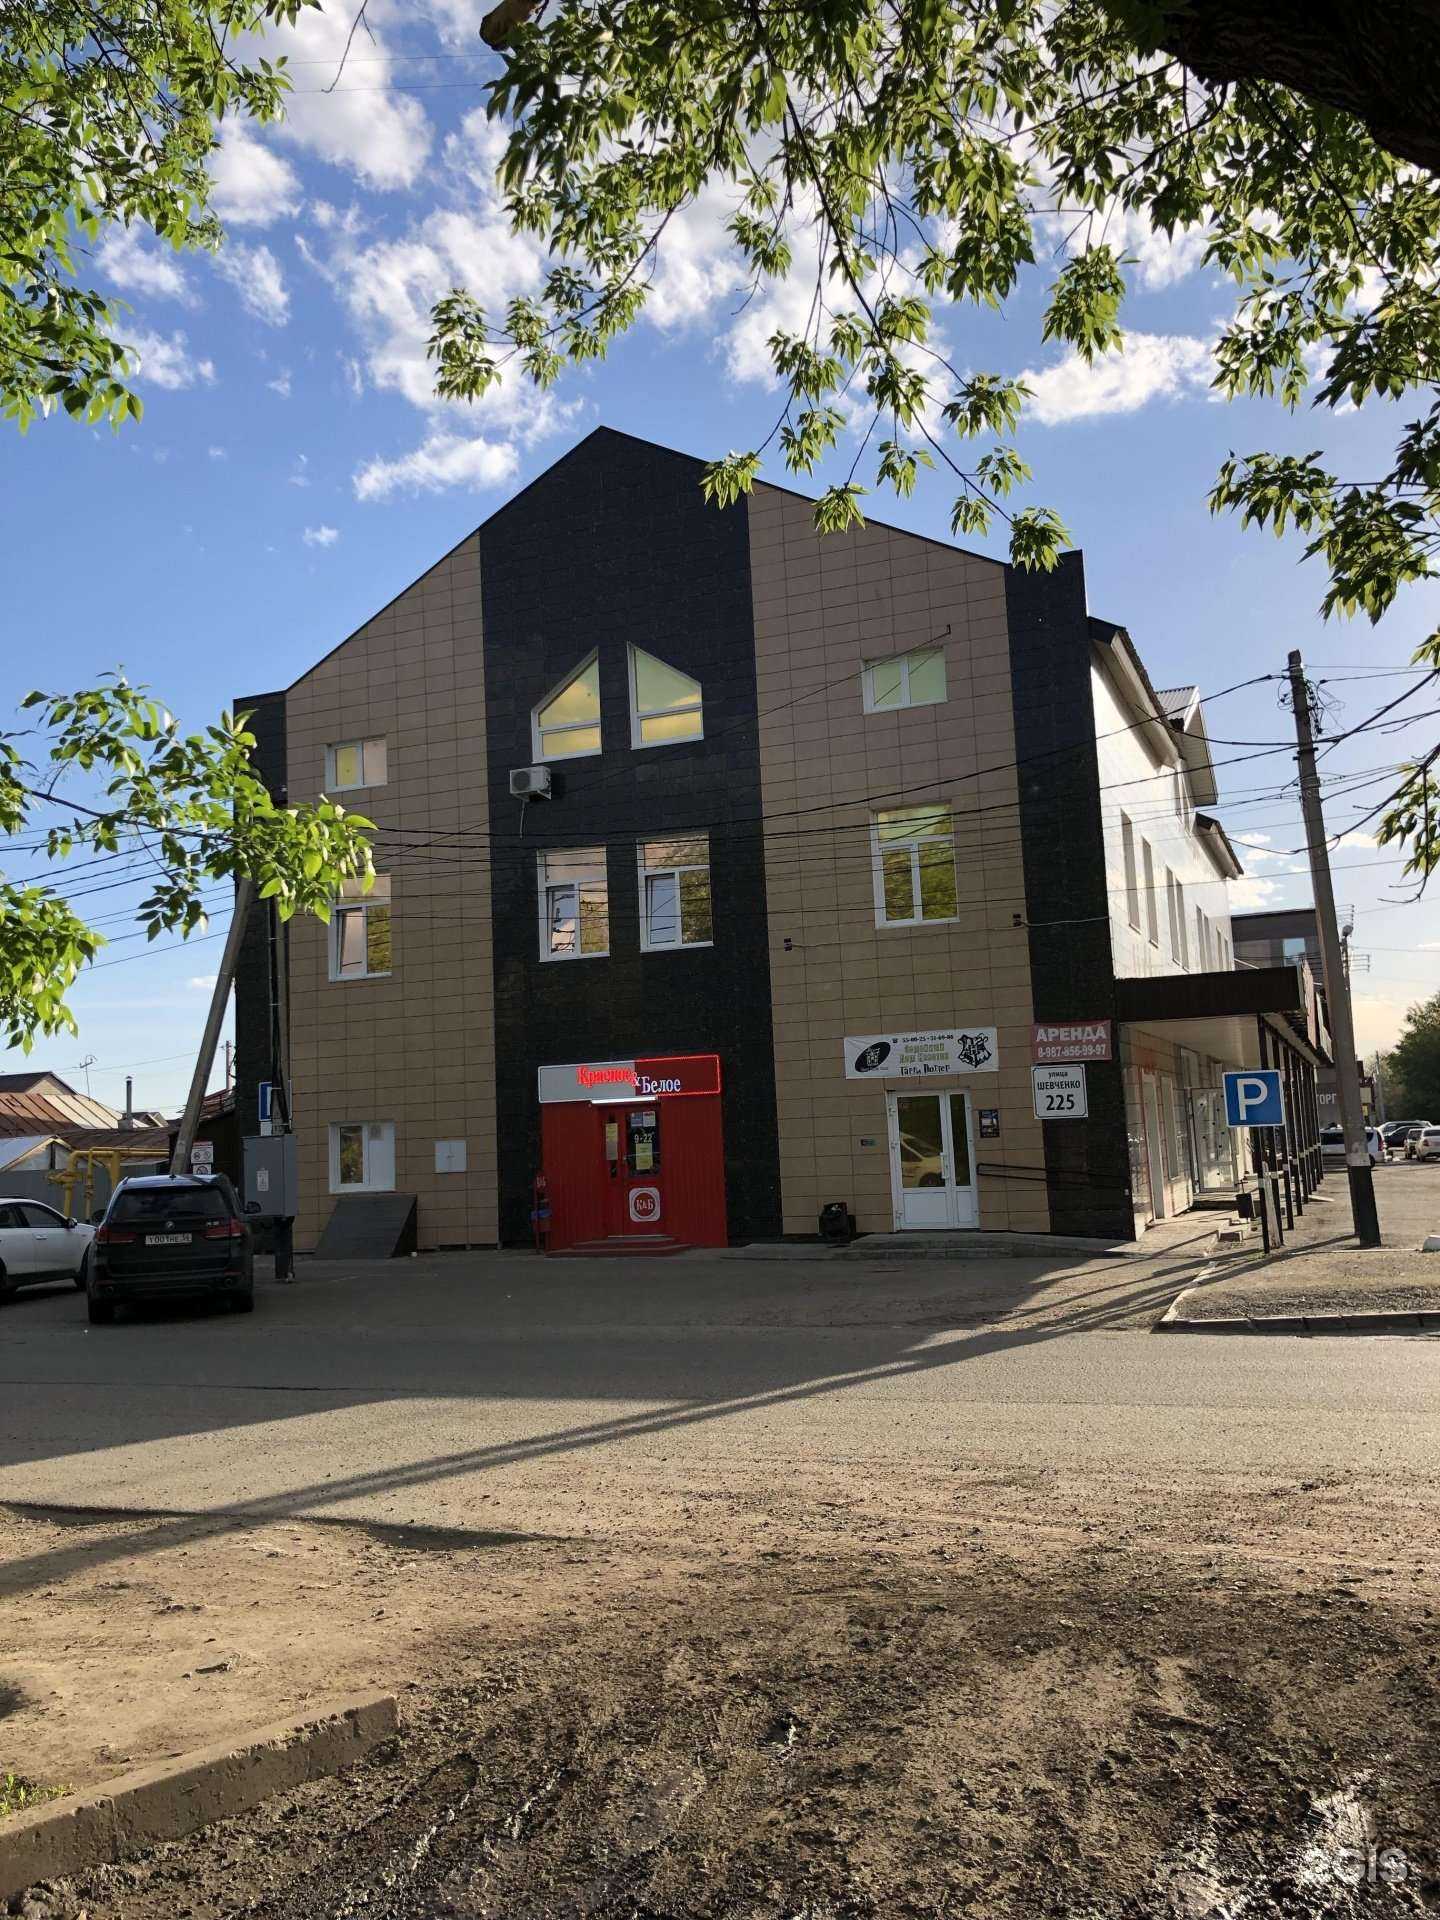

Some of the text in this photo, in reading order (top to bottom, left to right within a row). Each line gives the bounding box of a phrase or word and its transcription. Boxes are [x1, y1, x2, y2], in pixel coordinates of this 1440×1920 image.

[1036, 1025, 1107, 1042] АРЕНДА
[1048, 1071, 1068, 1079] улица
[641, 1075, 682, 1094] Белое
[1037, 1080, 1081, 1090] ШЕВЧЕНКО
[1046, 1094, 1075, 1111] 225
